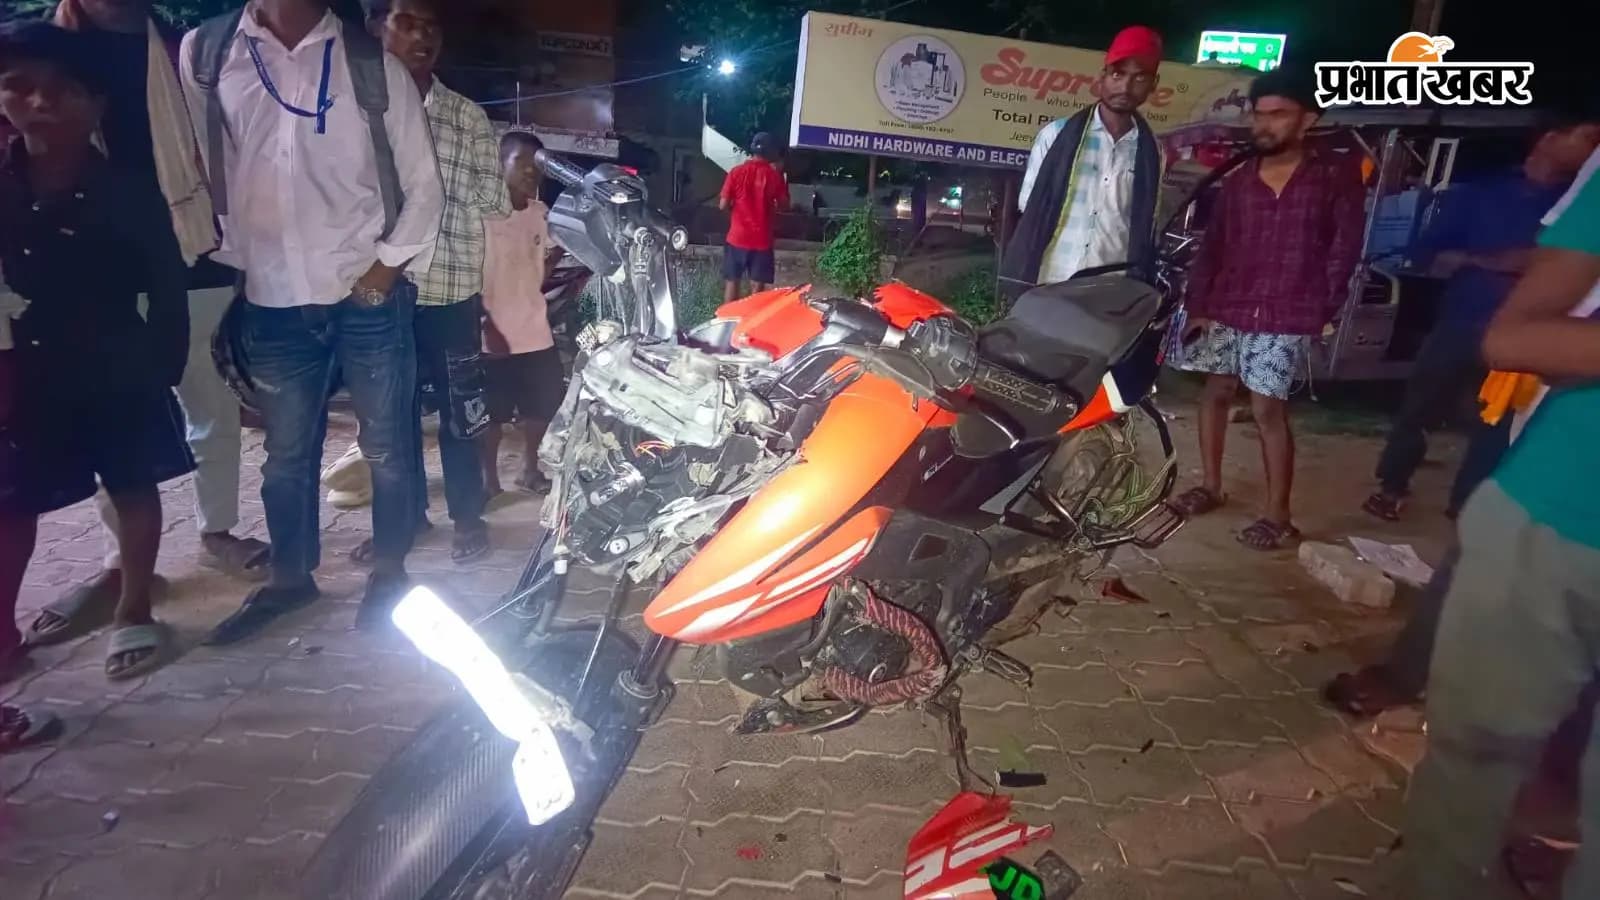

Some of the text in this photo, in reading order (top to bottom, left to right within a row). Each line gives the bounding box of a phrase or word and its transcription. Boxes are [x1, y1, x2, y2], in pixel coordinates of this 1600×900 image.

[983, 88, 1028, 103] People
[1046, 96, 1070, 108] who
[992, 108, 1032, 124] Total
[828, 132, 869, 149] NIDHI
[873, 139, 953, 158] HARDWARE
[956, 147, 986, 162] AND
